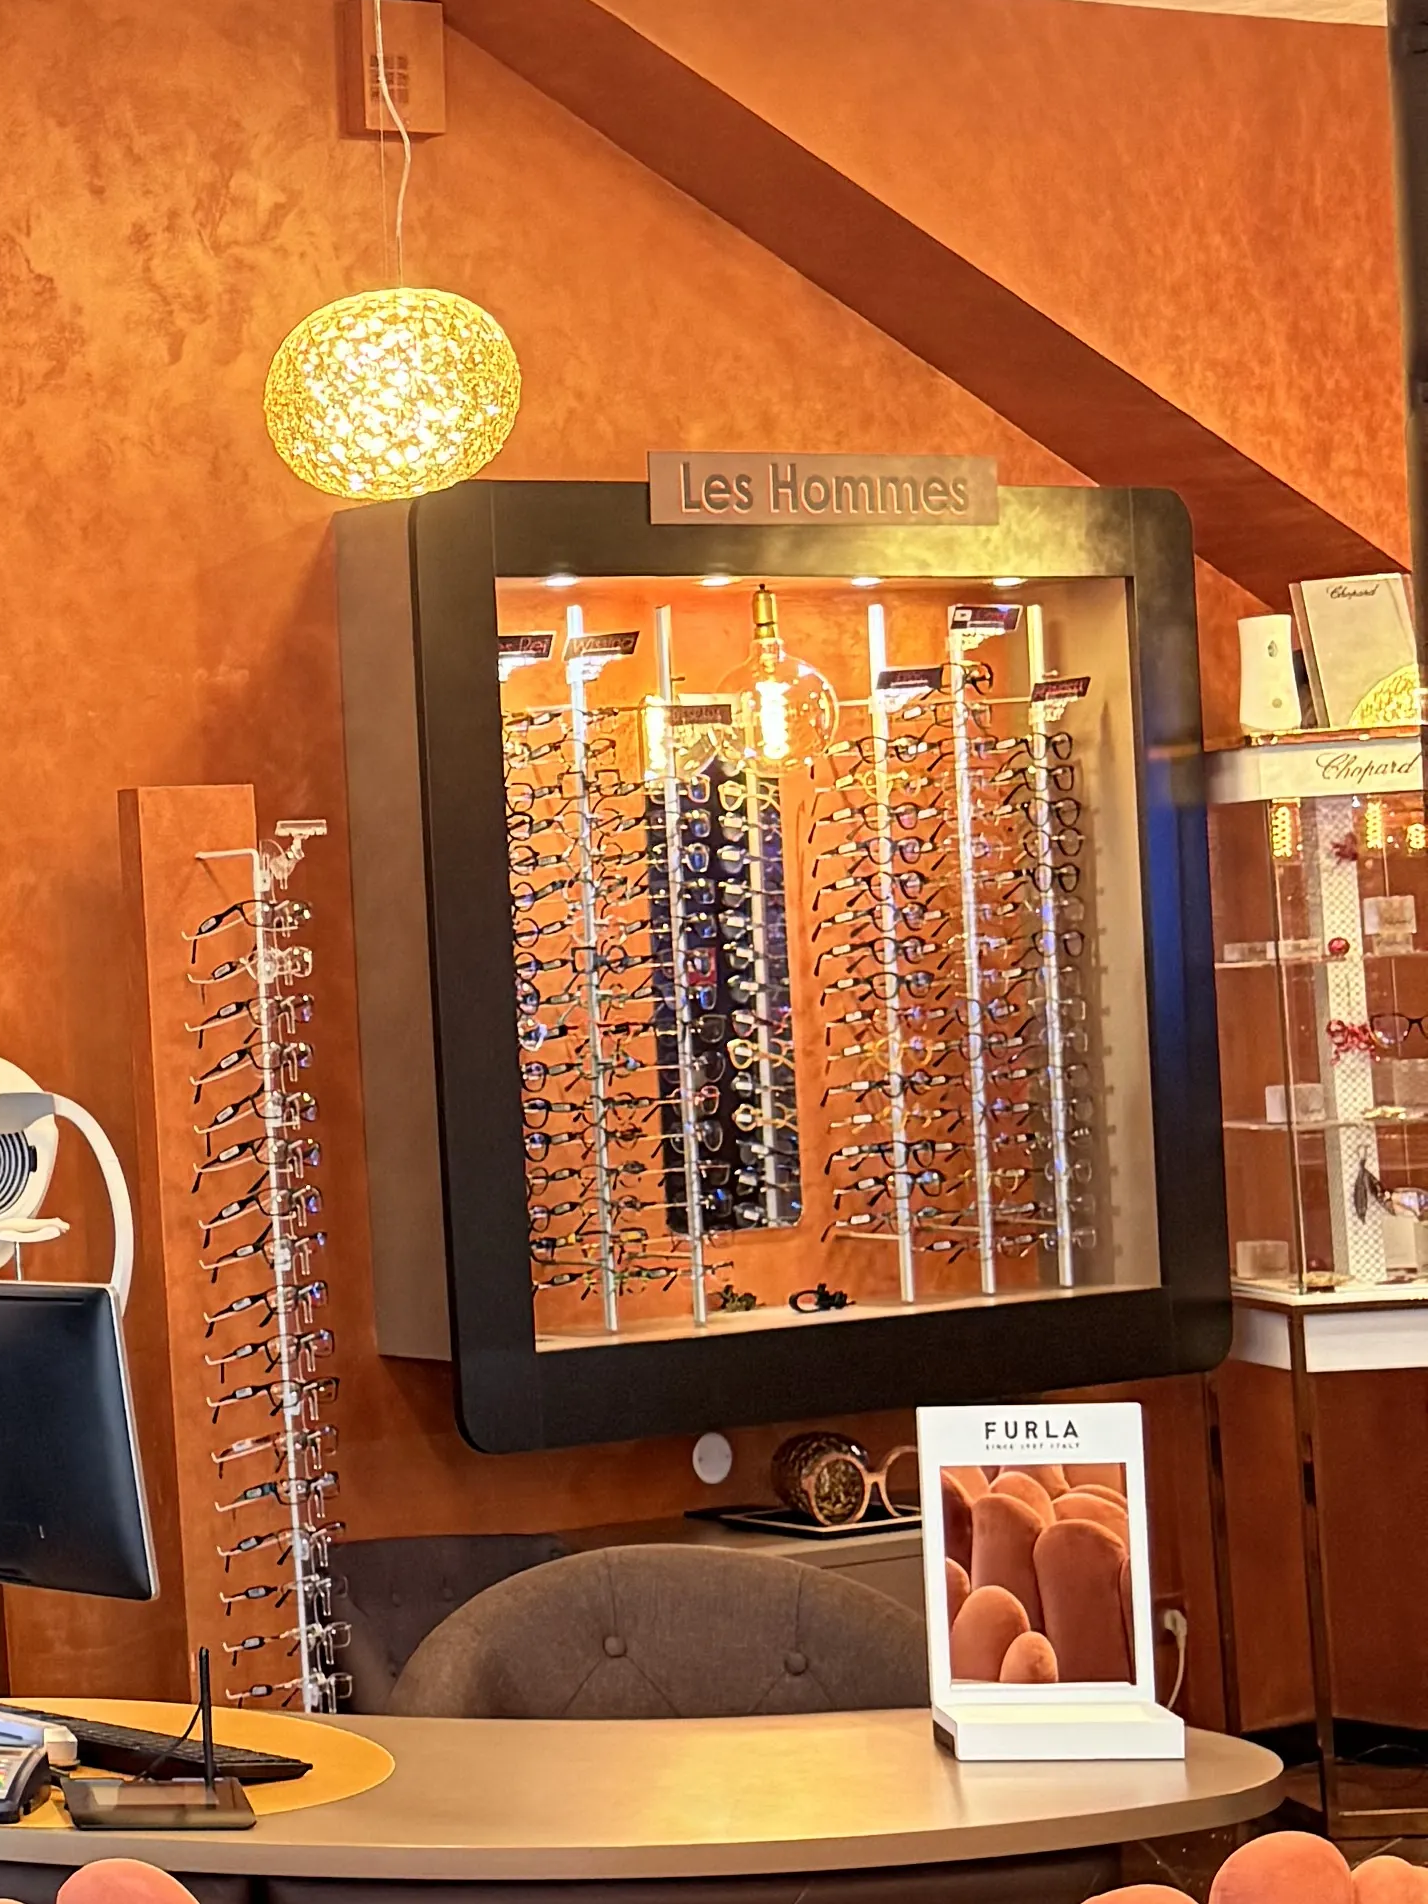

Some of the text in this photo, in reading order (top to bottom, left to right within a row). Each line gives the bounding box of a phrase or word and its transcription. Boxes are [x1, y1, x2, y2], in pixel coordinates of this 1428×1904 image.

[680, 461, 970, 516] Les Hommes
[1326, 584, 1379, 600] Chopard
[1316, 751, 1422, 784] Chopard
[985, 1419, 1079, 1440] FURLA
